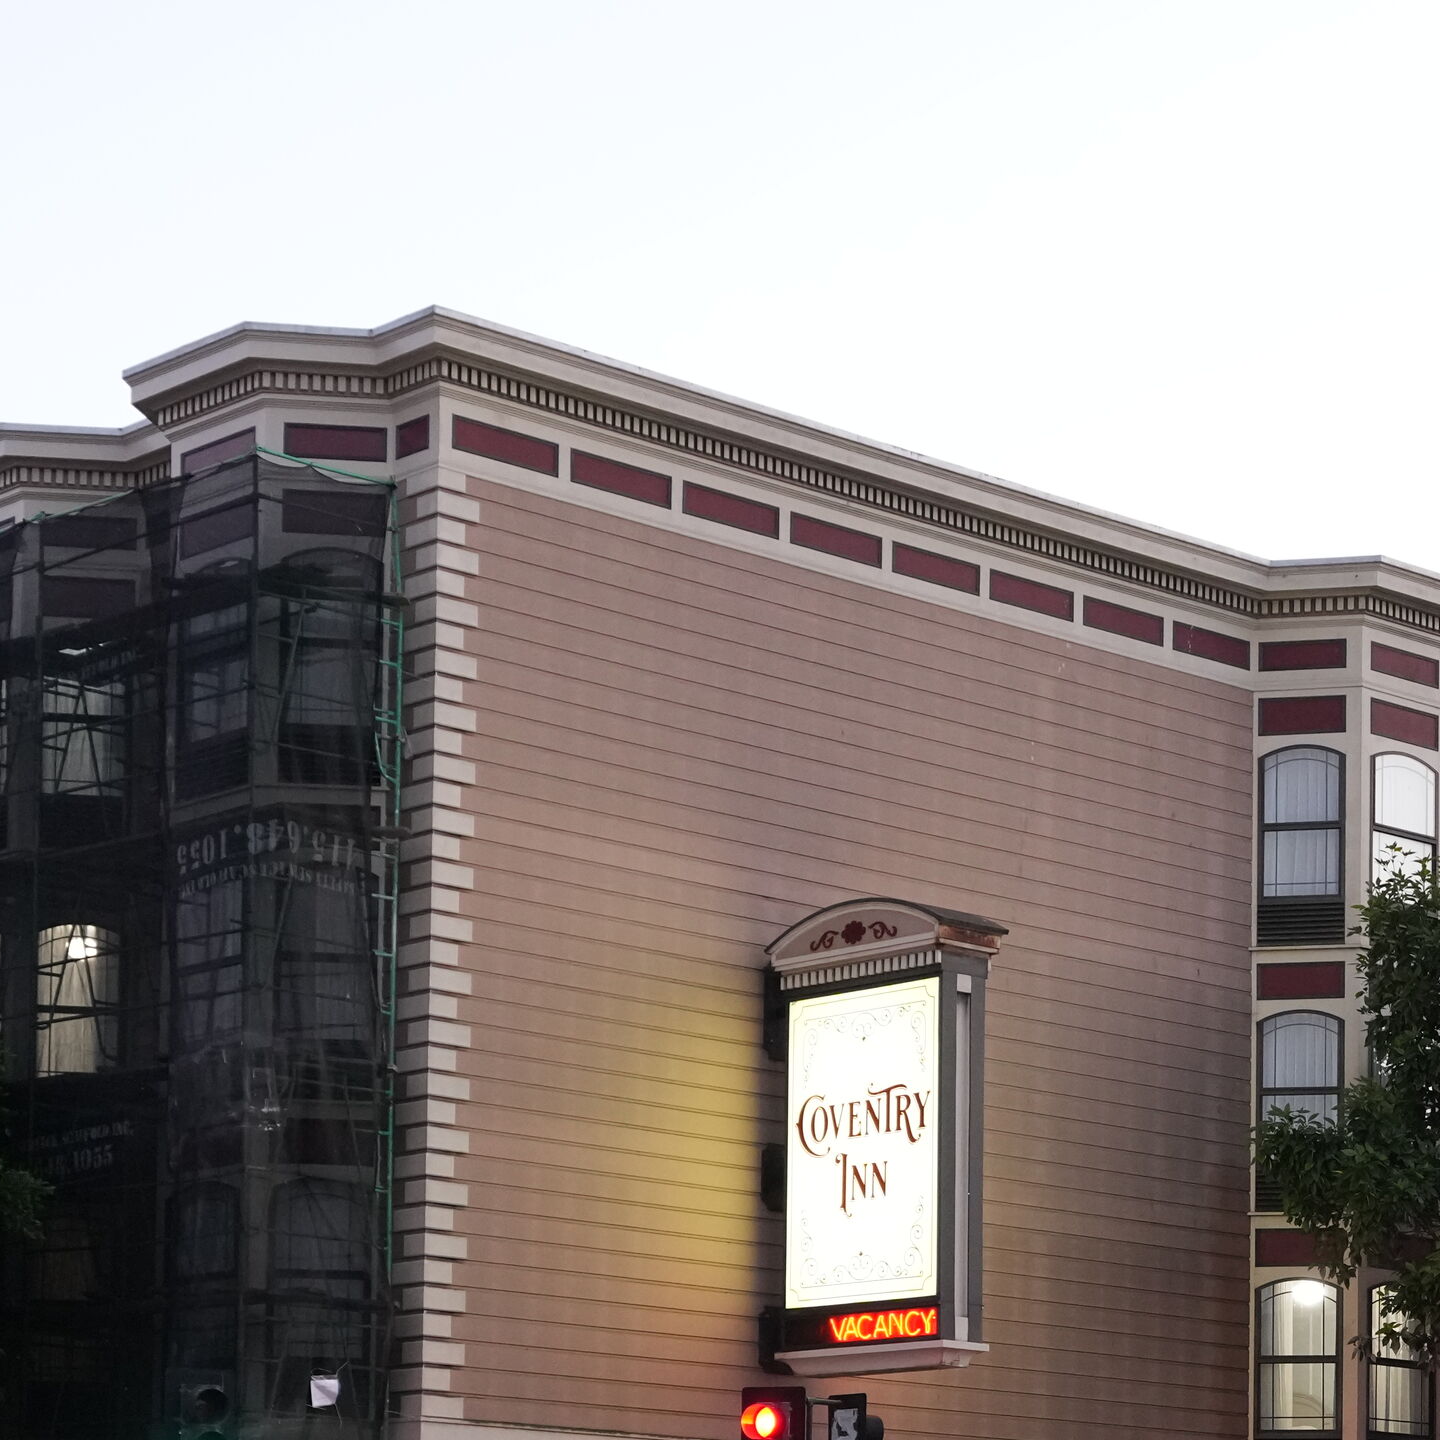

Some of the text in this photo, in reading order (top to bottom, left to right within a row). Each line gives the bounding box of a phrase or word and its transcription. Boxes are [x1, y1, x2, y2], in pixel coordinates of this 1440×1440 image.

[795, 1083, 932, 1159] COVENTRY
[835, 1152, 889, 1218] INN
[829, 1309, 937, 1342] VACANCY
